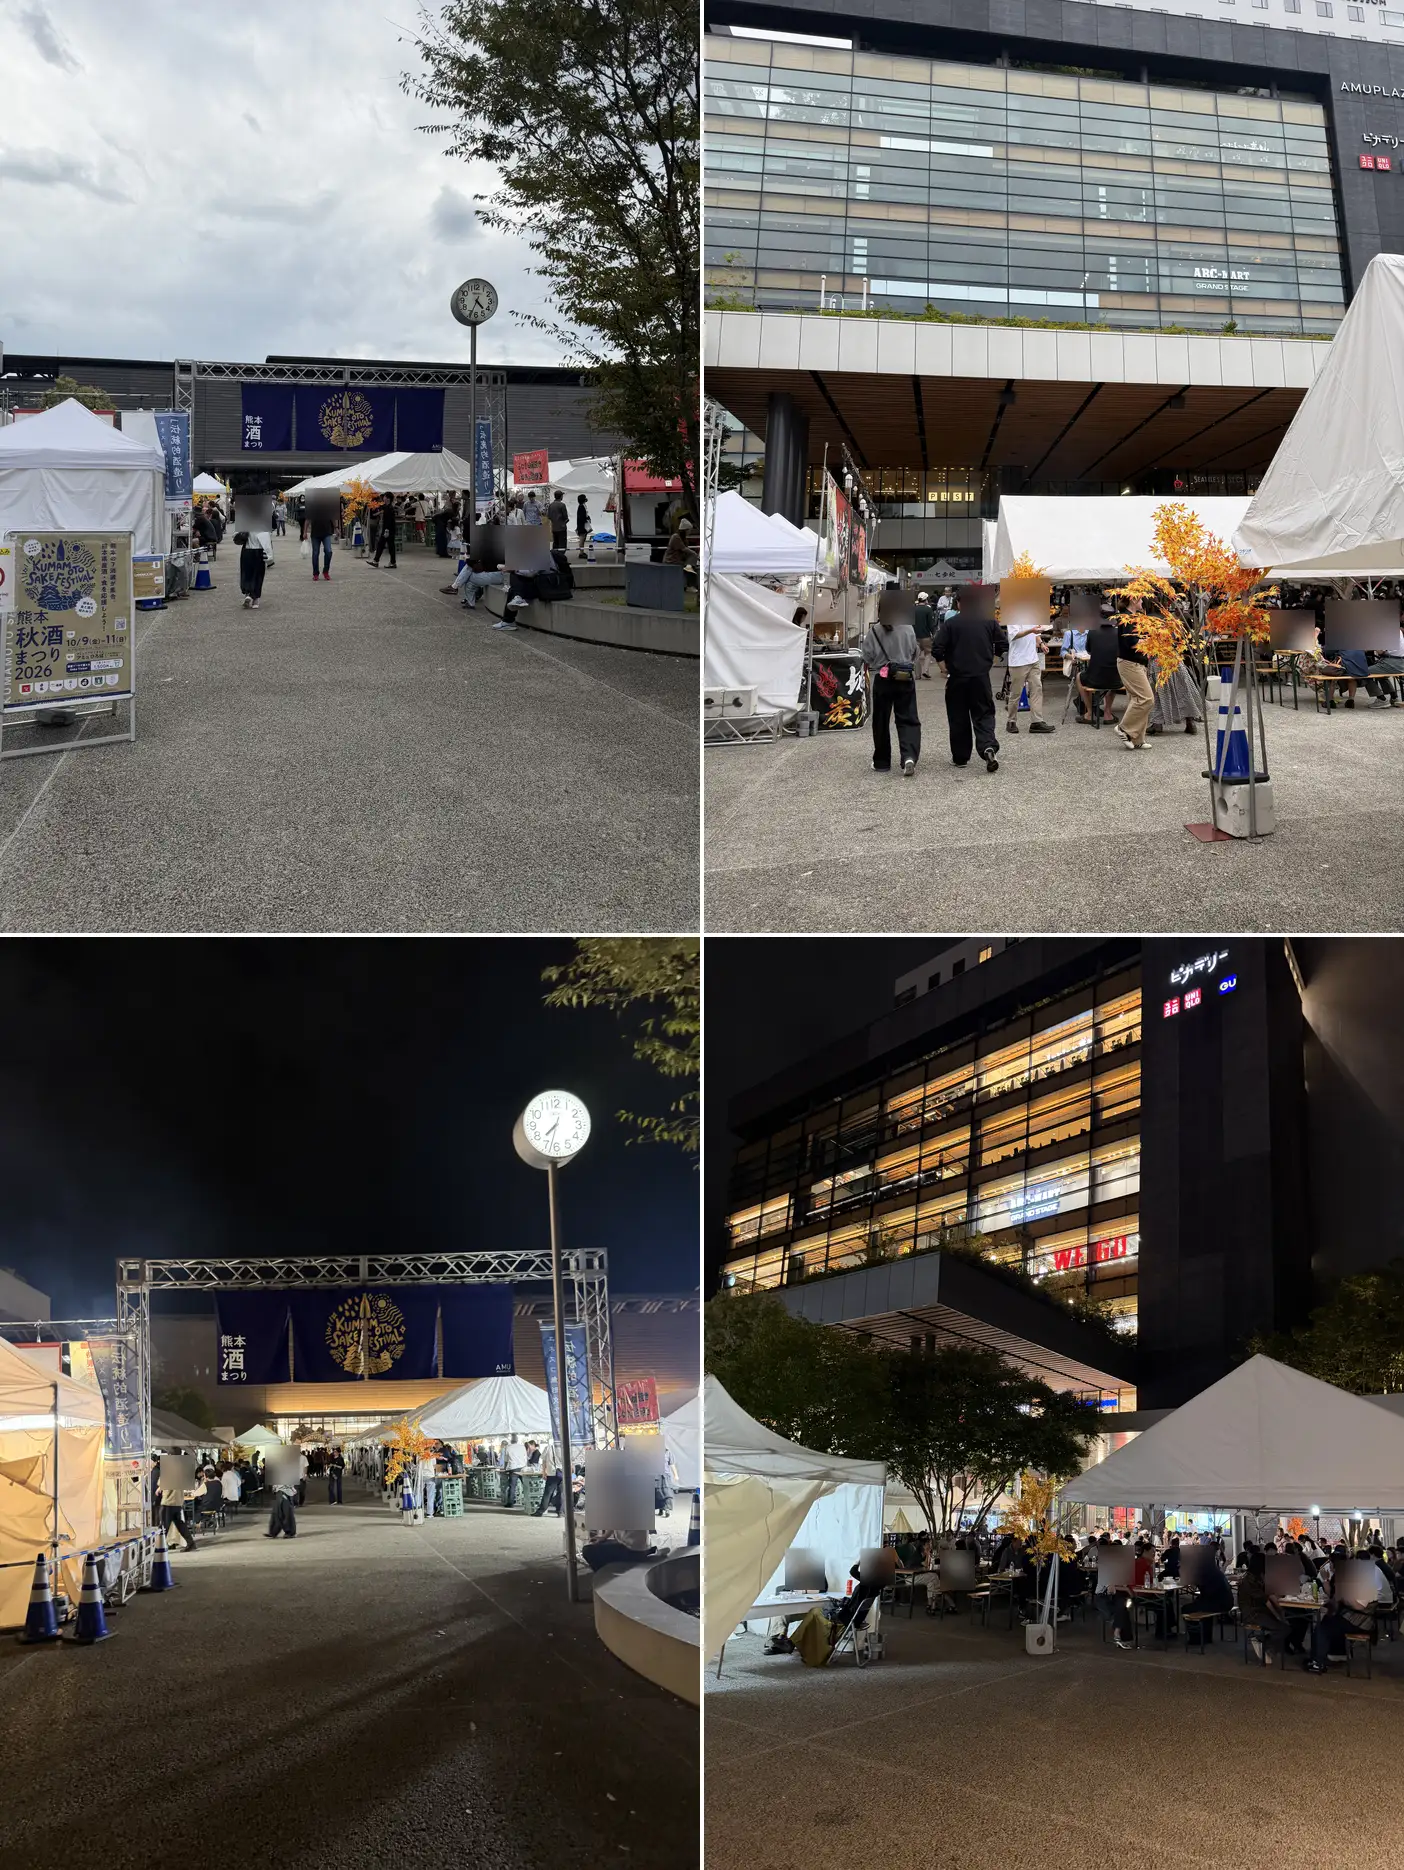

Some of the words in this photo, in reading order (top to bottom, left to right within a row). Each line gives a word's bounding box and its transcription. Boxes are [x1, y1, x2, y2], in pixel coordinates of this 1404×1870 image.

[325, 406, 364, 420] KUMMOTO
[245, 415, 263, 424] 熊本
[347, 417, 372, 430] ESTIVAL
[245, 425, 262, 440] 酒
[32, 559, 85, 576] KUMAMOTO
[26, 571, 55, 586] SAKE
[53, 570, 94, 589] FESTIVAL
[17, 610, 49, 625] 熊本
[15, 625, 64, 649] 秋酒
[15, 647, 60, 666] まつり
[15, 664, 52, 680] 2026
[1170, 951, 1229, 984] ピカデリー
[1220, 978, 1237, 991] GU
[541, 1101, 548, 1110] 11
[551, 1098, 560, 1108] 12
[532, 1110, 541, 1119] 10
[572, 1109, 578, 1118] 2
[530, 1121, 536, 1130] 9
[575, 1120, 582, 1129] 3
[534, 1131, 541, 1140] 8
[572, 1131, 579, 1140] 4
[543, 1140, 550, 1149] 7
[553, 1142, 560, 1152] 6
[565, 1140, 571, 1149] 5
[221, 1335, 246, 1347] 熊本
[330, 1330, 359, 1347] SAKE
[369, 1328, 404, 1351] ESTIVAL
[223, 1349, 245, 1370] 酒
[496, 1363, 511, 1371] AMU
[221, 1371, 247, 1381] まつり
